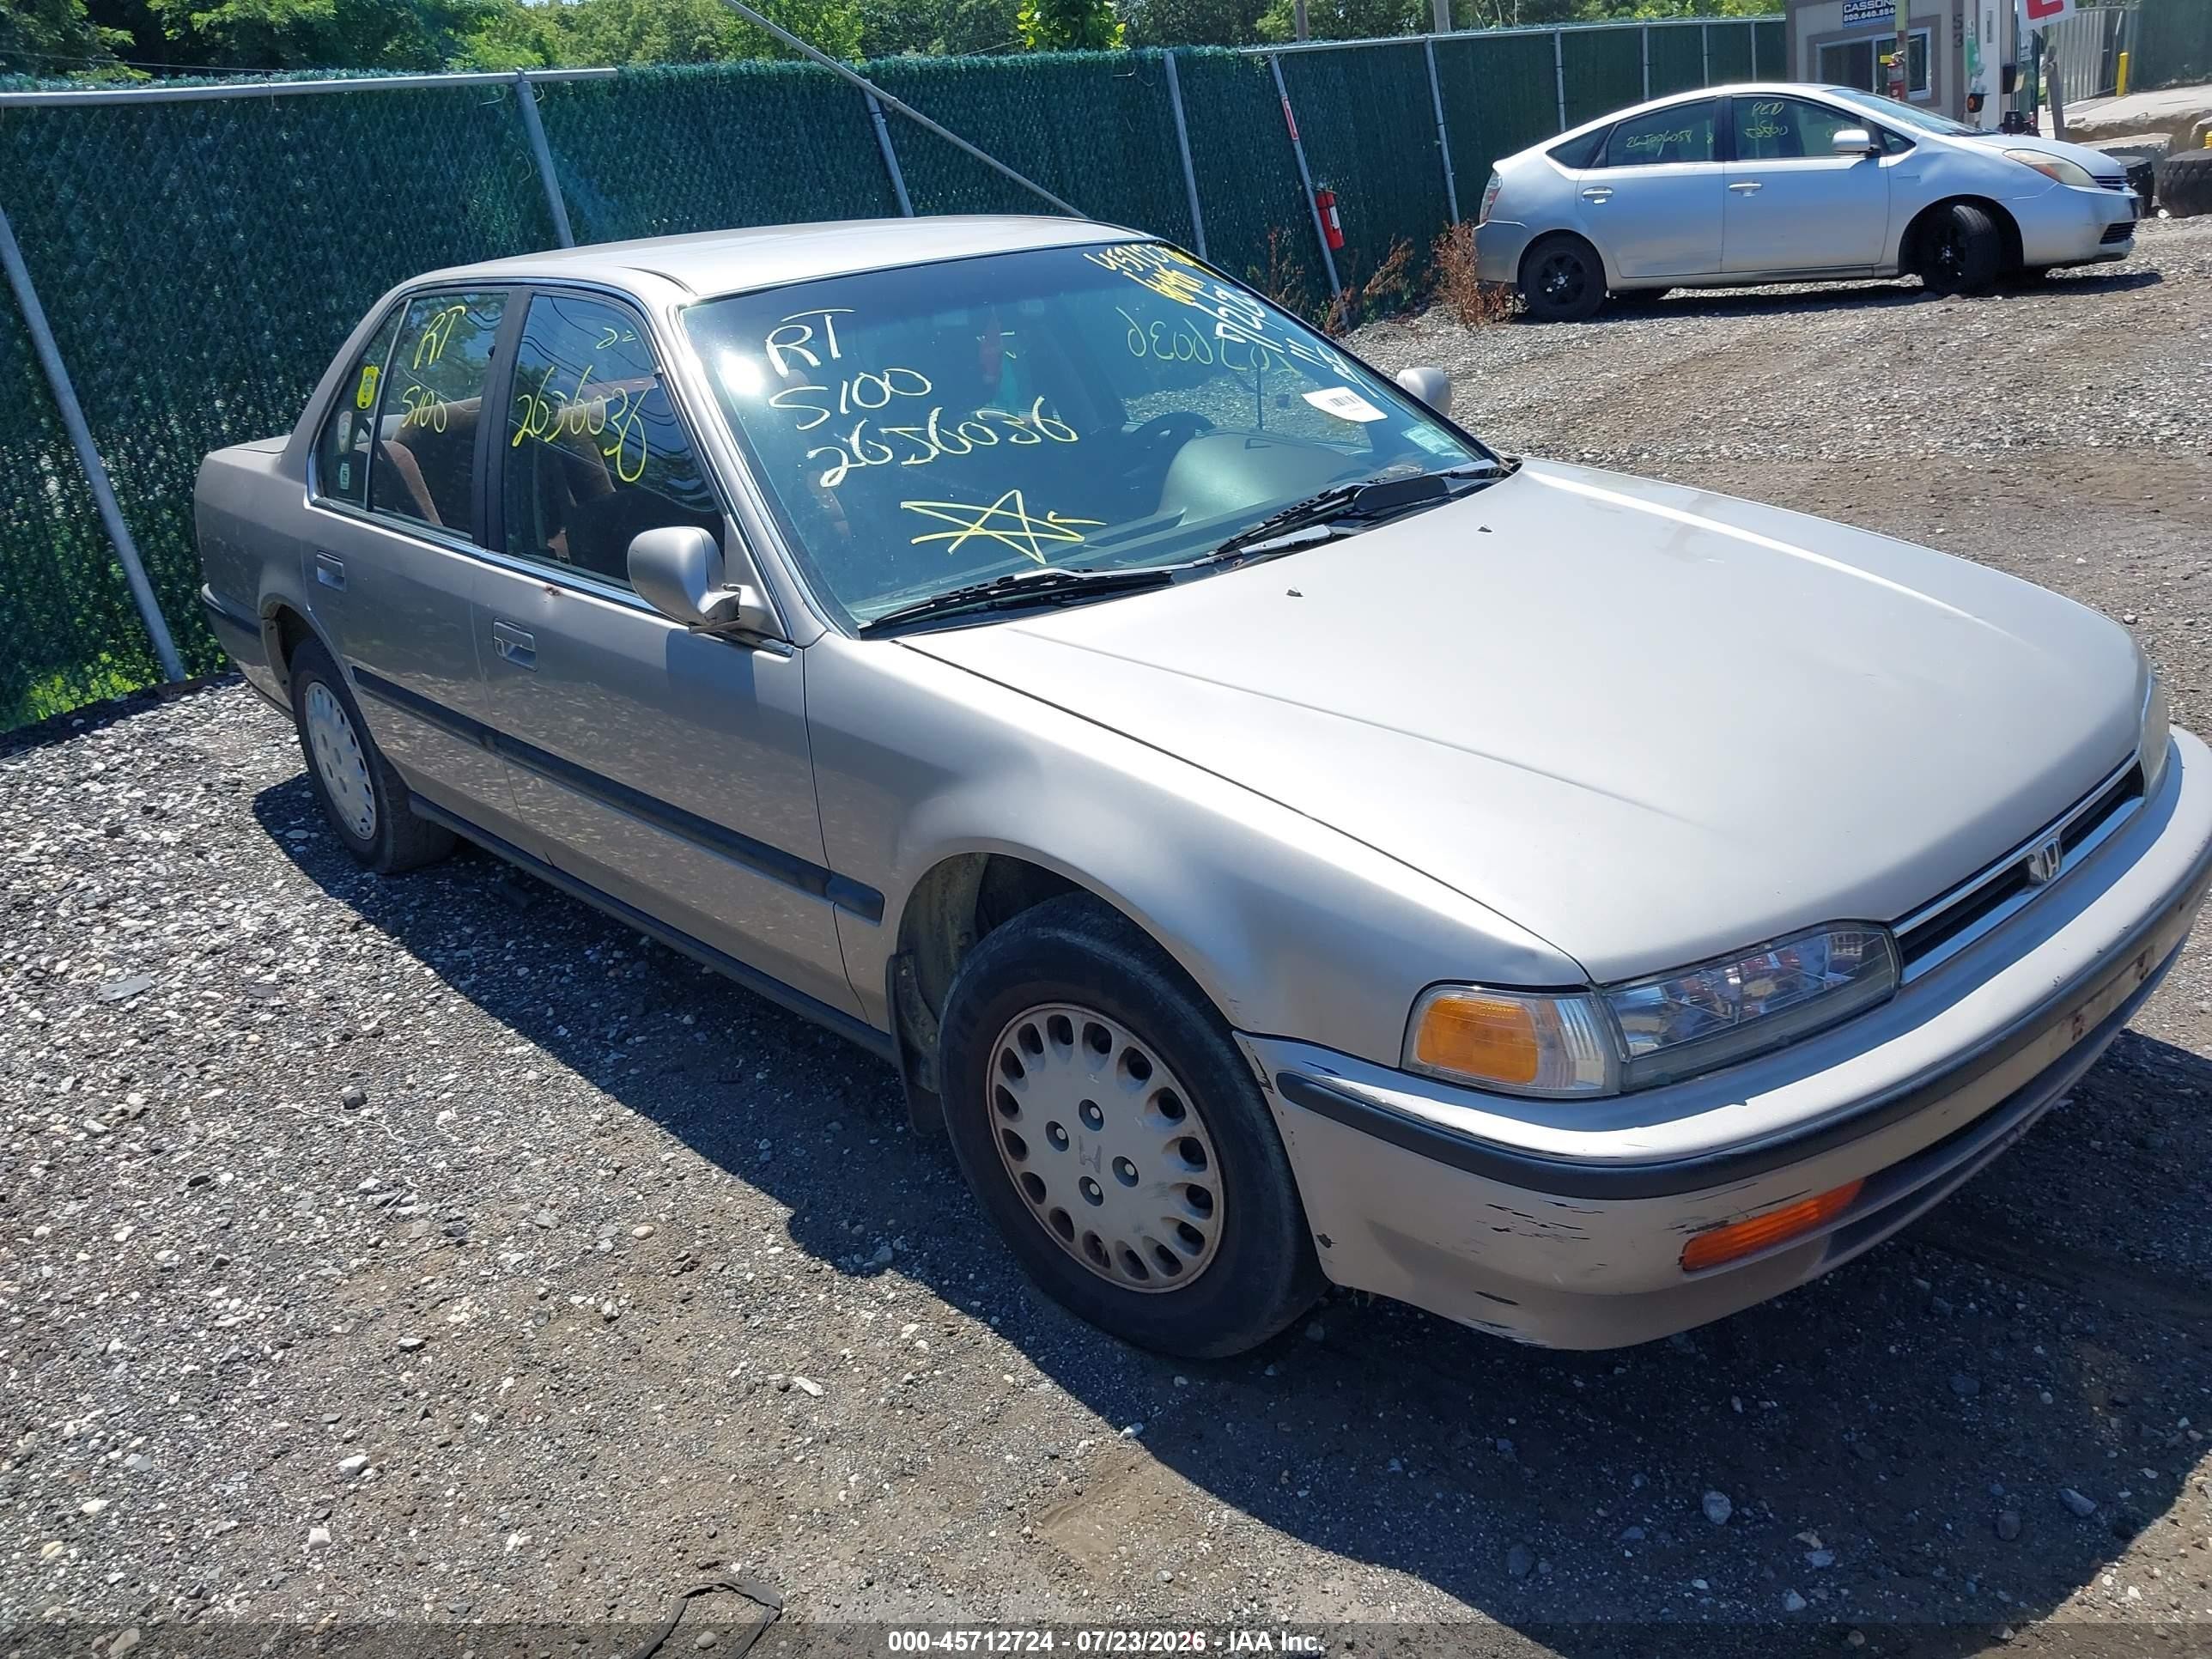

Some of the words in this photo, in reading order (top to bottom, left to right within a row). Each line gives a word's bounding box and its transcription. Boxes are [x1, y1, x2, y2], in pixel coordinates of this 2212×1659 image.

[1844, 7, 1896, 21] 800.640.884
[413, 305, 467, 371] RT
[765, 308, 857, 378] RT
[401, 385, 448, 434] S100
[769, 367, 933, 431] S100
[805, 395, 1079, 488] 2656036
